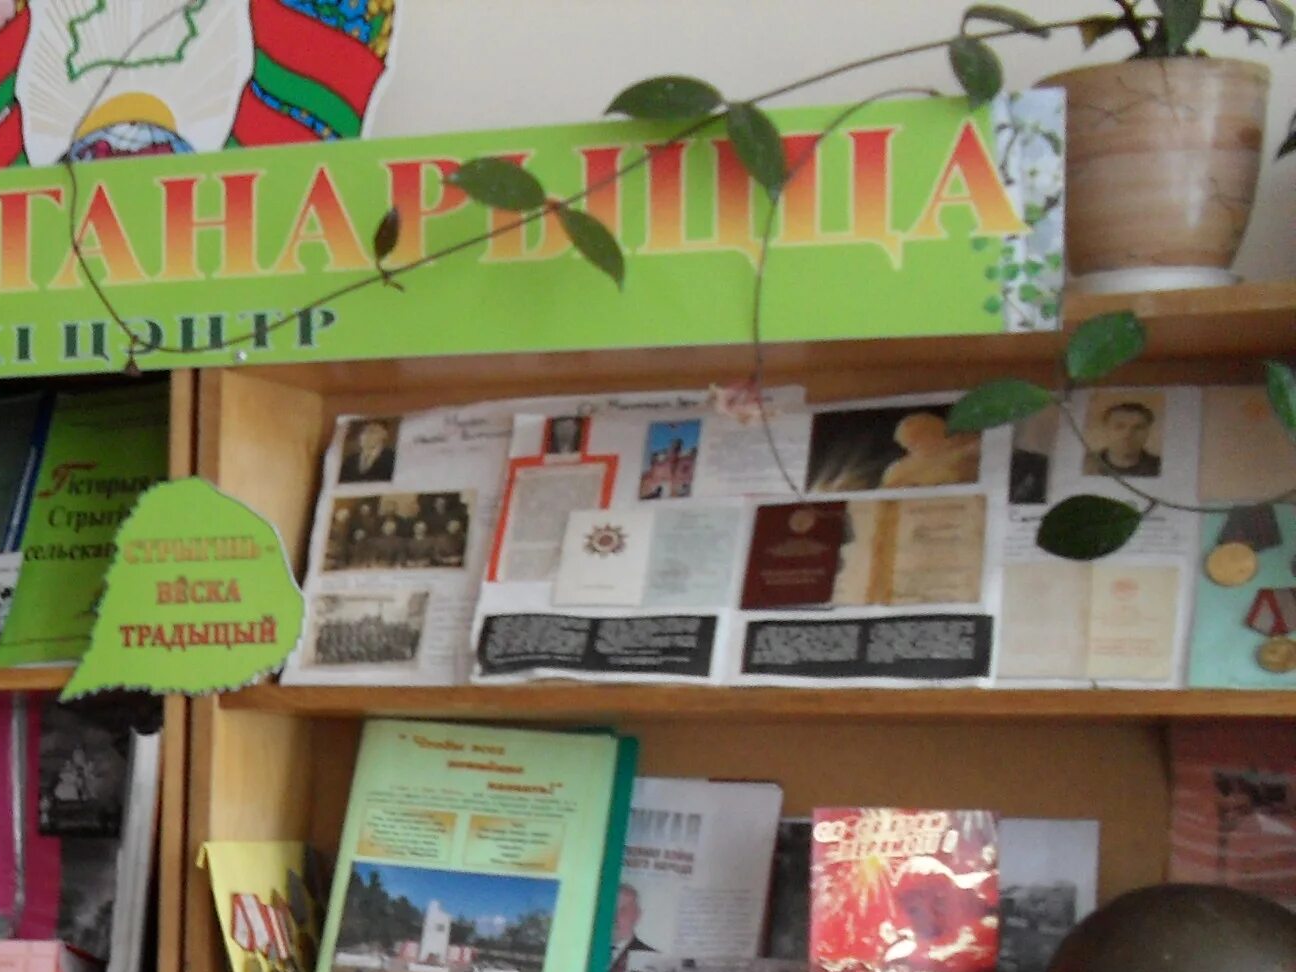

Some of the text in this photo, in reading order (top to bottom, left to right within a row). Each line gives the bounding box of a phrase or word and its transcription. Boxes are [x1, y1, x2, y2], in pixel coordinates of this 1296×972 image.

[62, 308, 337, 361] ЦЭНТР
[156, 574, 242, 606] ВЁСКА
[119, 615, 277, 651] ТРАДЫЦЫЙ
